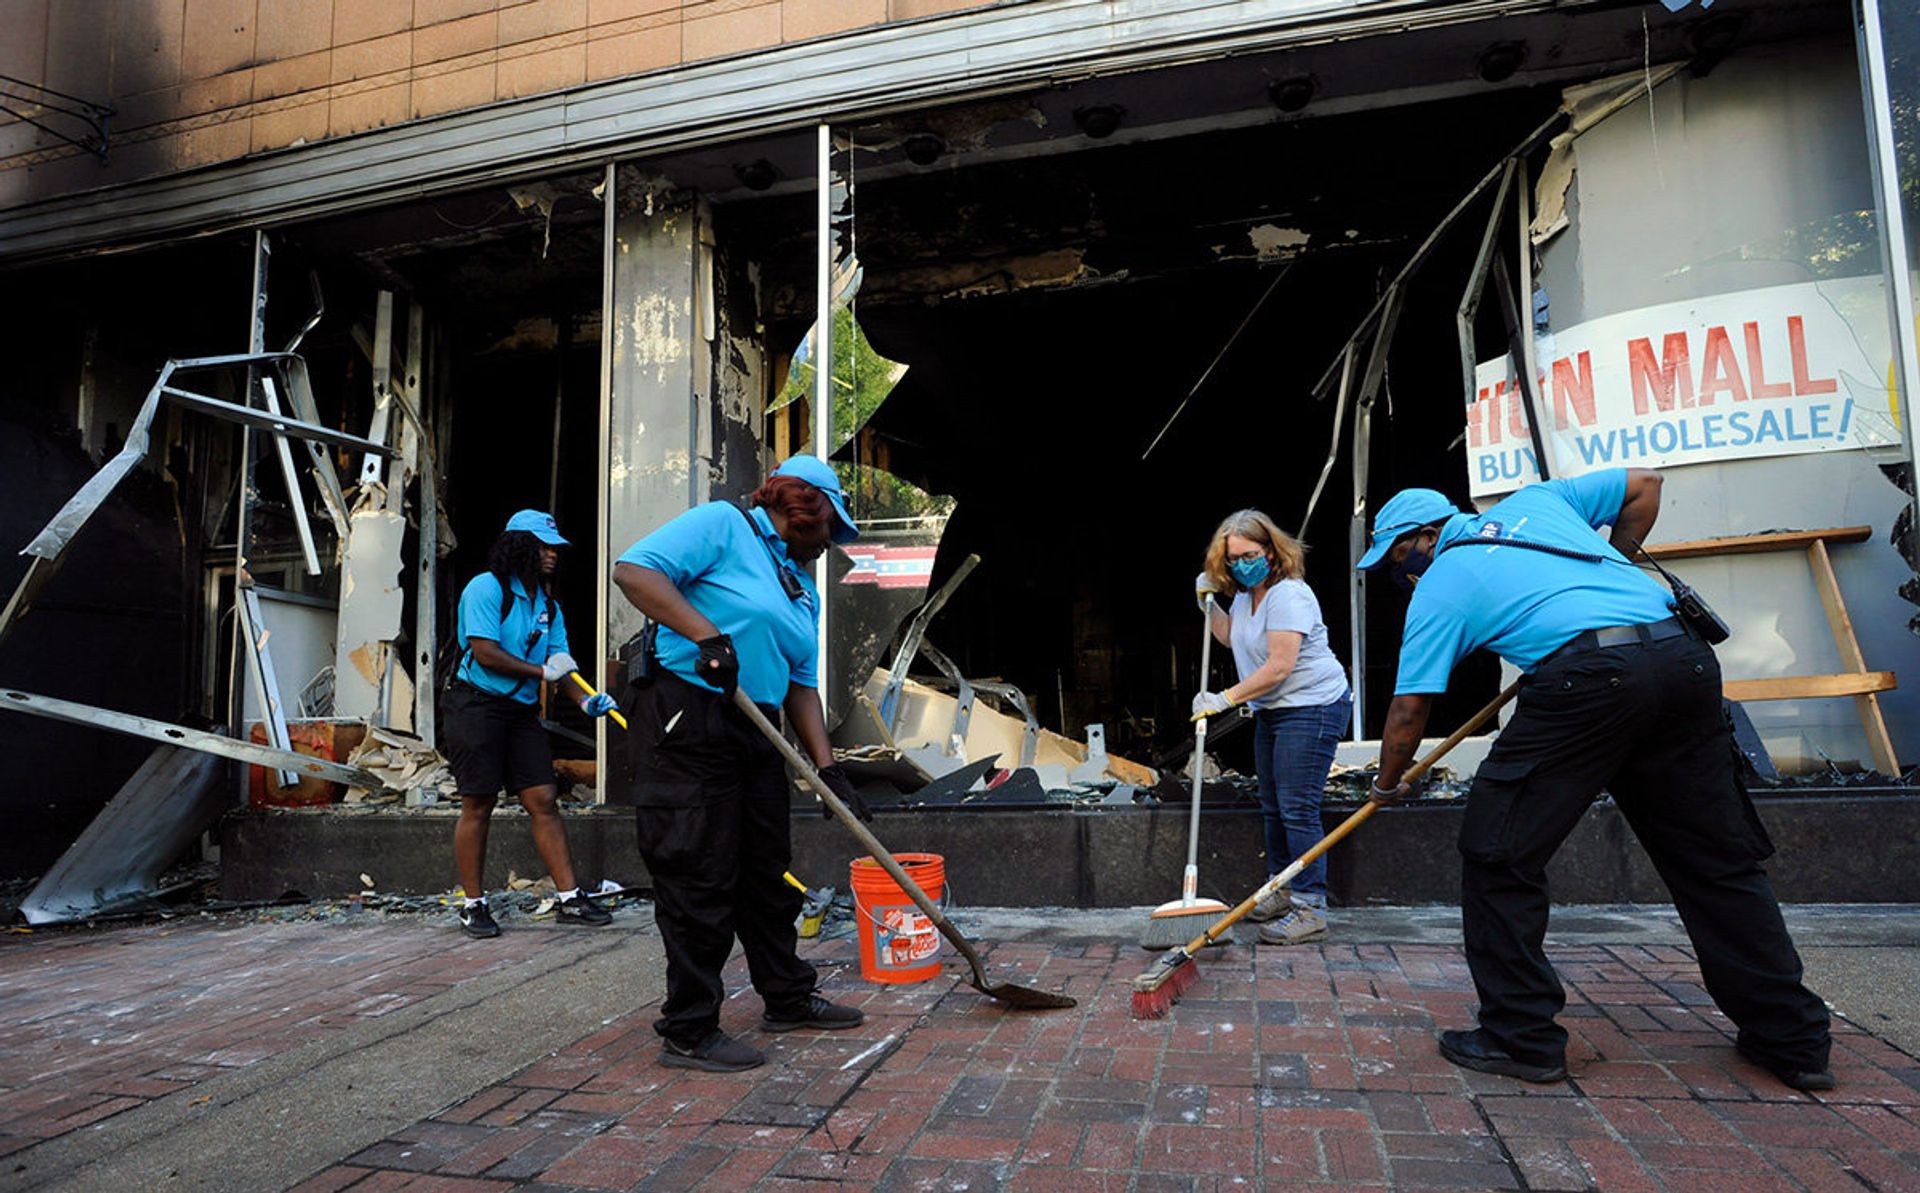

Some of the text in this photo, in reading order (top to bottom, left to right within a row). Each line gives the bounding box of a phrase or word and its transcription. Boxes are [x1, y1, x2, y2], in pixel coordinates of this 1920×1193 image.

[1627, 315, 1838, 416] MALL
[1479, 398, 1854, 483] BUY WHOLESALE!
